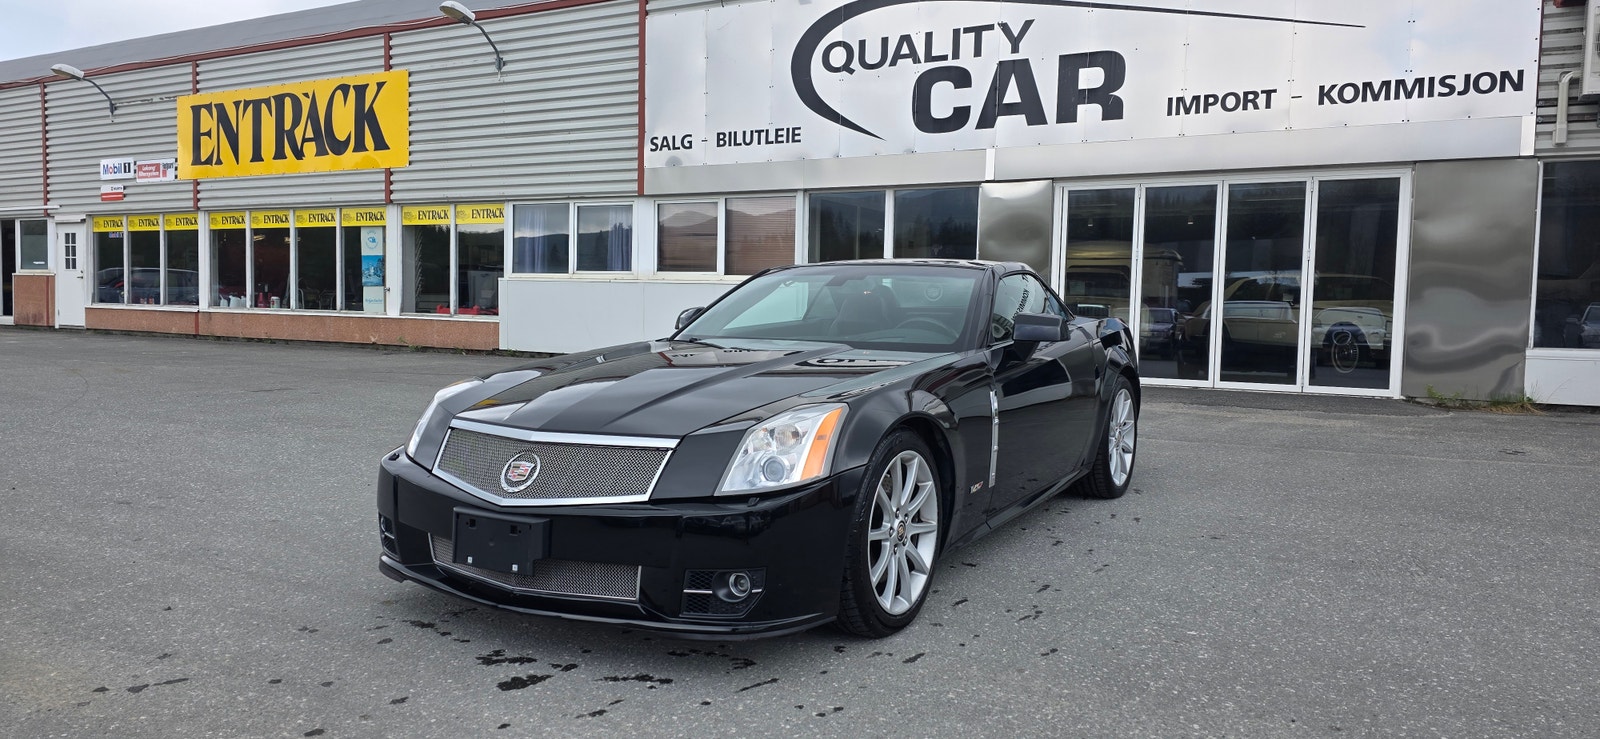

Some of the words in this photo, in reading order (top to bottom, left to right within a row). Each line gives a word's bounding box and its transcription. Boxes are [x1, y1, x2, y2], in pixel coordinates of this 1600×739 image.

[821, 18, 1036, 76] QUALITY
[912, 50, 1127, 134] CAR
[1166, 89, 1278, 117] IMPORT
[1317, 69, 1525, 106] KOMMISJON
[649, 133, 693, 153] SALG
[716, 127, 802, 149] BILUTLEIE
[102, 163, 123, 175] Mobil
[263, 214, 290, 224] ENTRACK
[308, 213, 336, 223] ENTRACK
[355, 211, 385, 222] ENTRACK
[417, 209, 449, 221] ENTRACK
[471, 208, 505, 219] ENTRACK
[221, 215, 246, 225] ENTRACK
